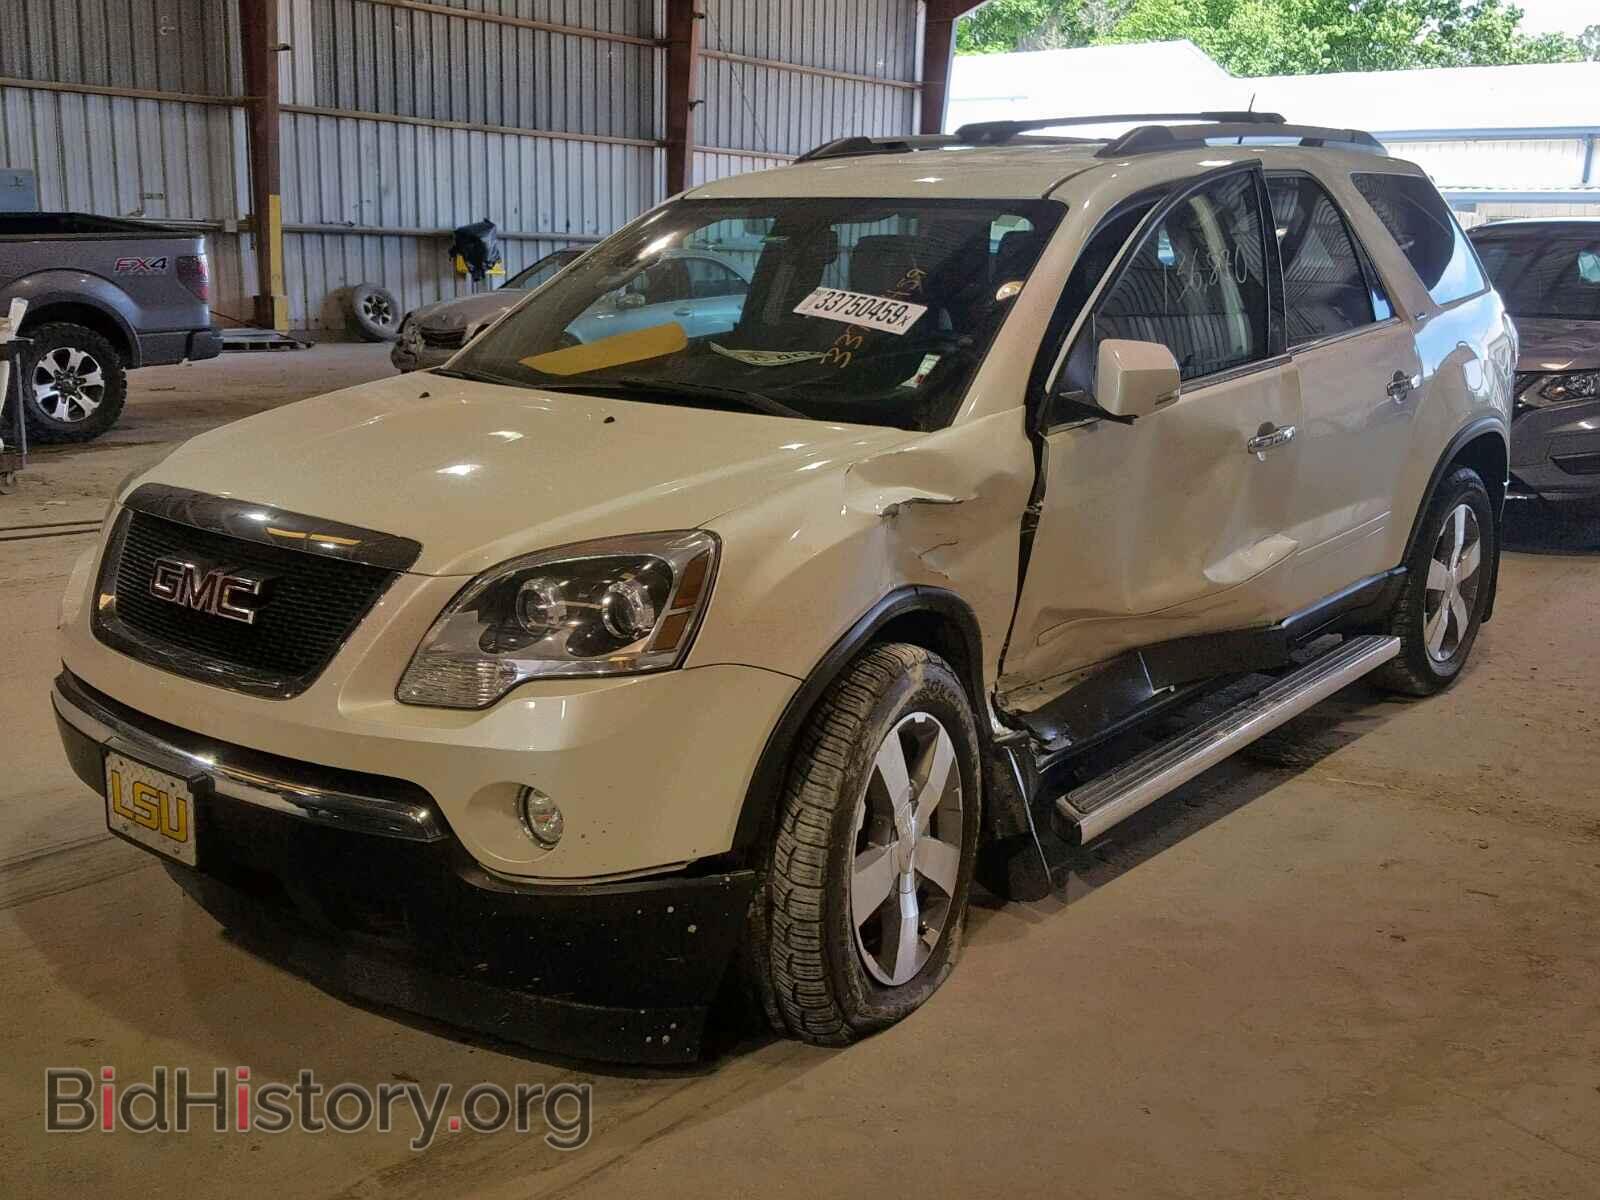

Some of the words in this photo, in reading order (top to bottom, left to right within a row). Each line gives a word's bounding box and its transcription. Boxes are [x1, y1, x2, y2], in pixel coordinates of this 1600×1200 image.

[113, 255, 168, 272] FX4
[150, 558, 263, 624] GMC
[111, 769, 188, 843] LSU
